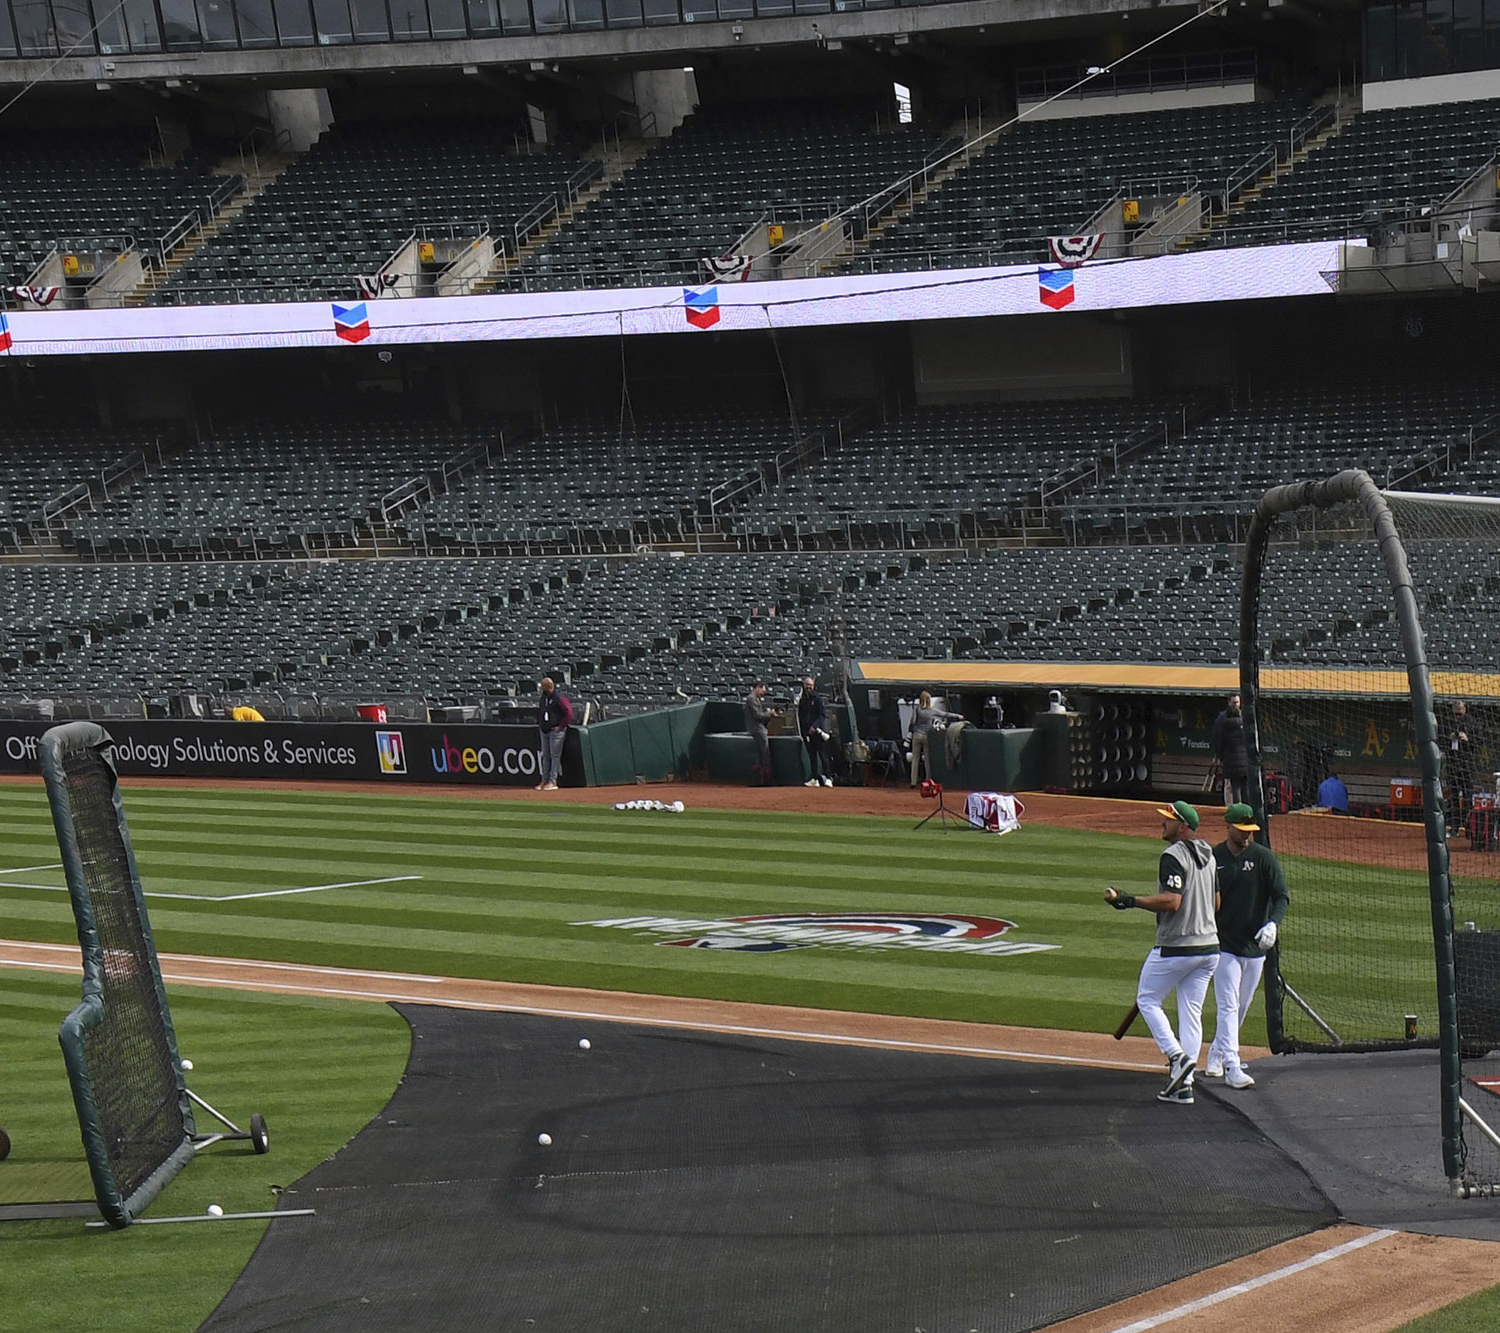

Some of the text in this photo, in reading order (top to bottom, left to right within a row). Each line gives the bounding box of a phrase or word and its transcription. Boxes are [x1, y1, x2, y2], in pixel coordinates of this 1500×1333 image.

[171, 738, 257, 764] Solutions
[263, 744, 279, 762] &
[282, 744, 357, 766] Services
[1166, 875, 1182, 889] 49
